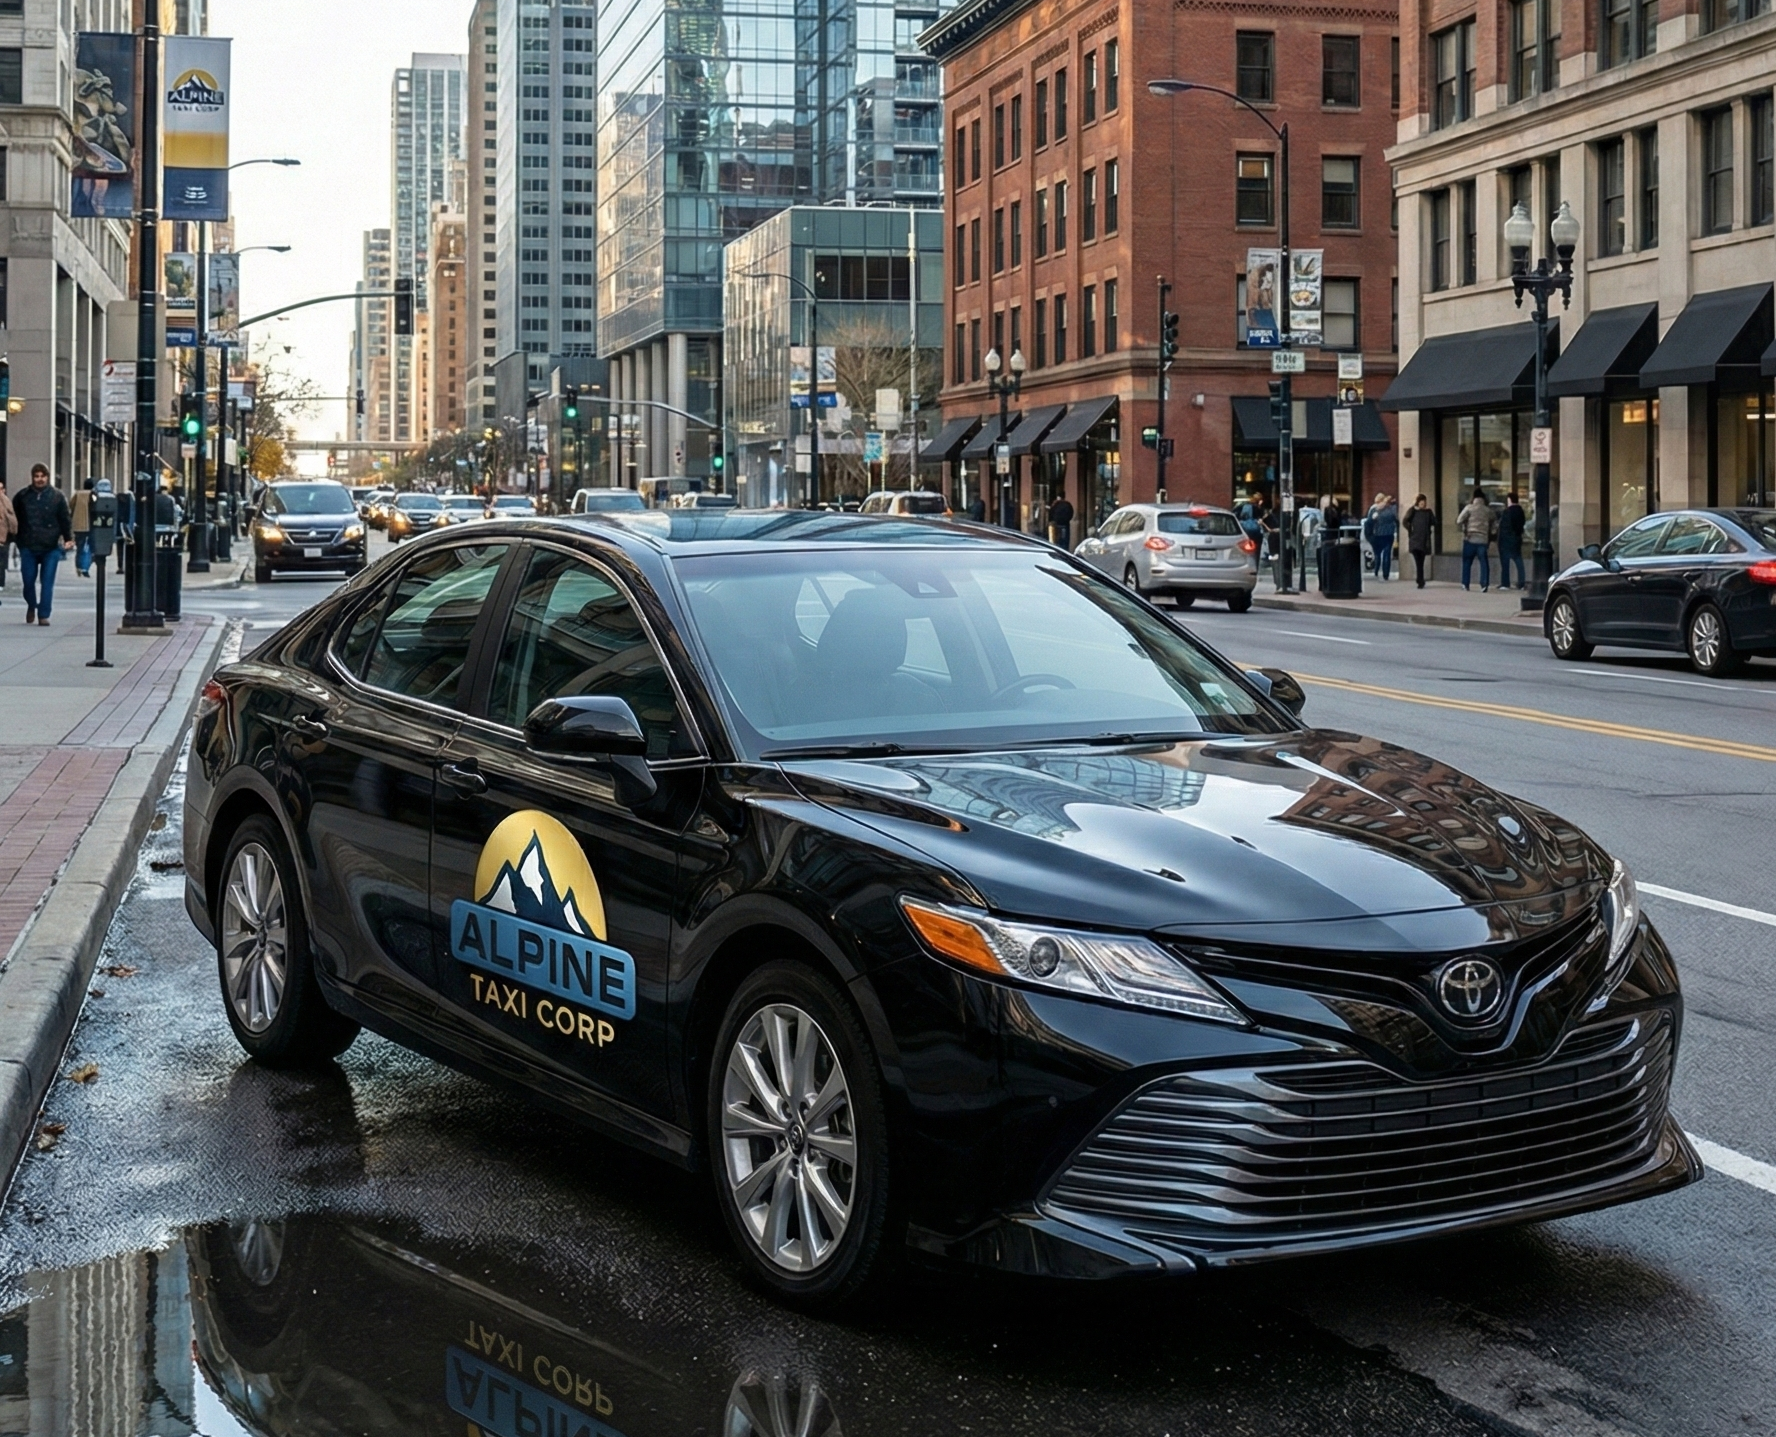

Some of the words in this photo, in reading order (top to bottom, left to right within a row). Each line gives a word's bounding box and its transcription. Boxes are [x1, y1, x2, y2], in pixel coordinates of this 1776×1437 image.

[458, 913, 626, 1009] ALPINE
[470, 973, 527, 1018] TAXI
[537, 1000, 615, 1047] CORP
